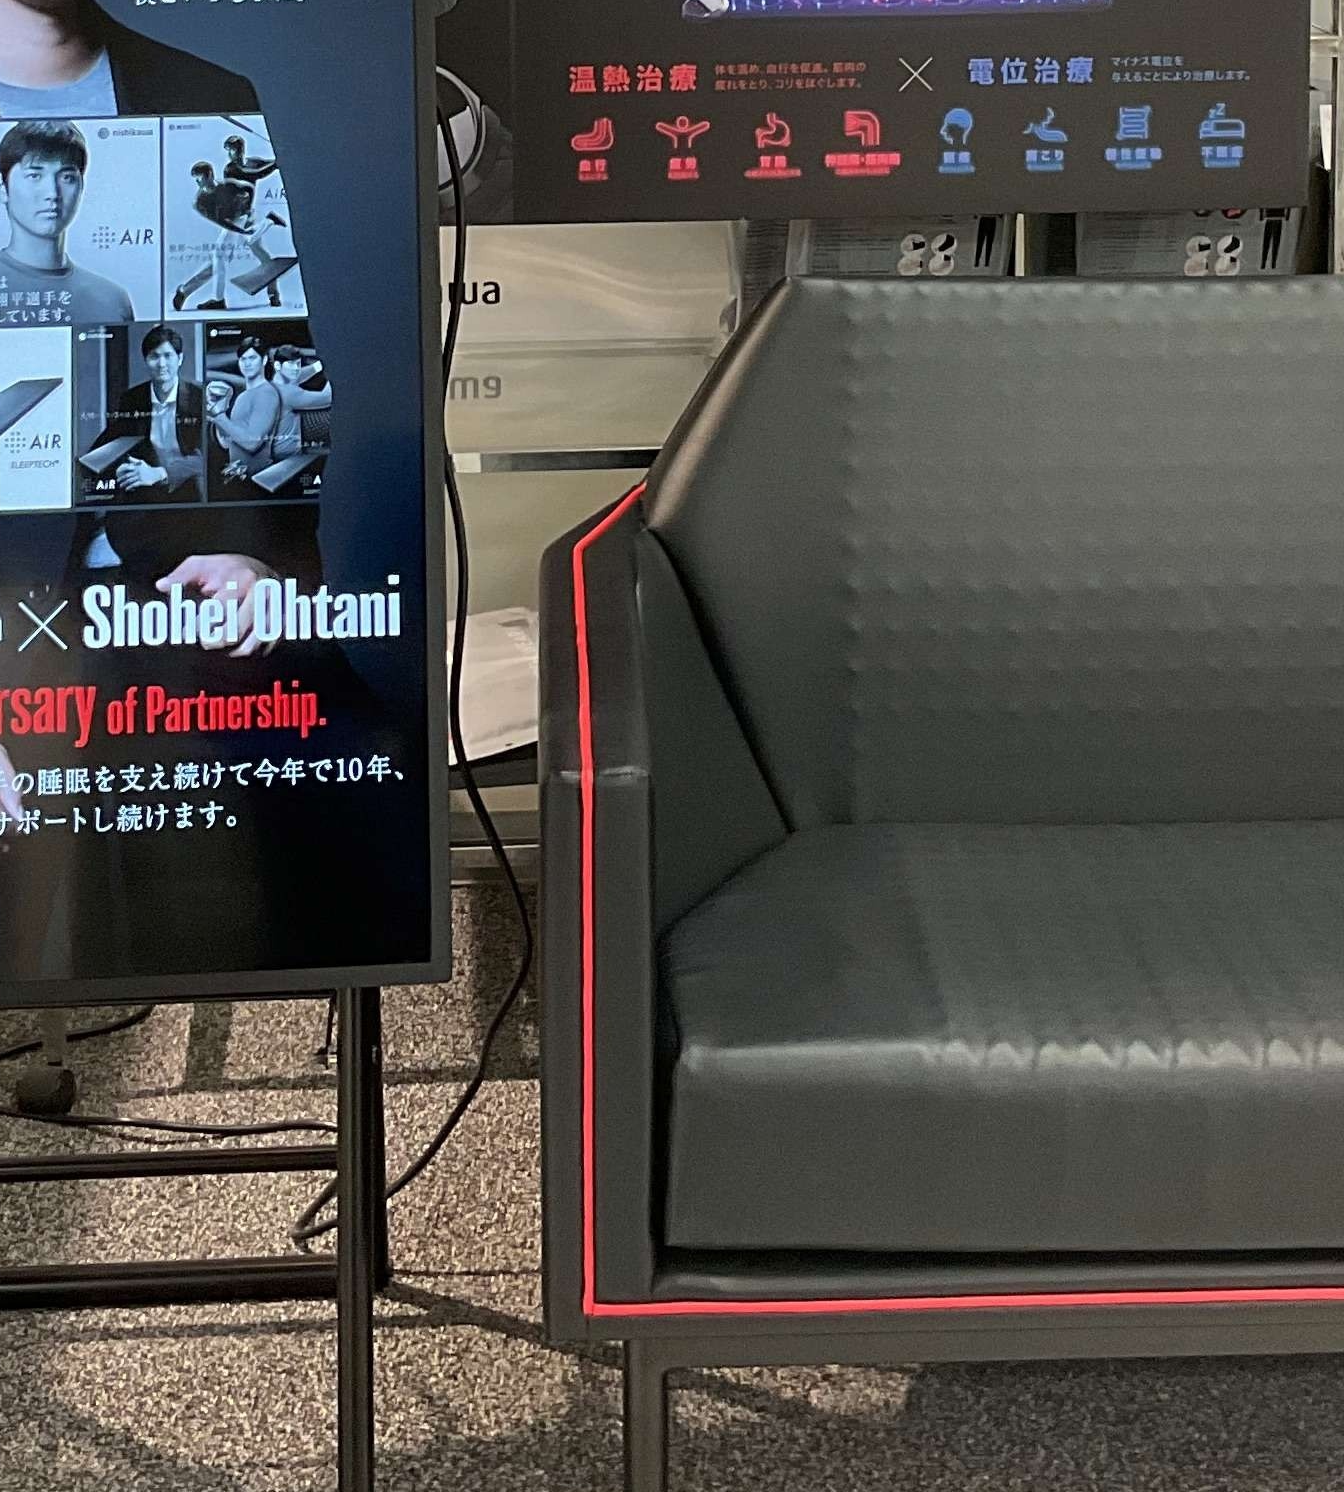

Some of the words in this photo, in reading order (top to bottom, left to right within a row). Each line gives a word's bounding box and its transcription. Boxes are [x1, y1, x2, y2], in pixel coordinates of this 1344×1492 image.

[569, 64, 698, 93] 温熱治療
[968, 57, 1095, 86] 電位治療
[84, 582, 241, 650] Shohei
[254, 575, 401, 643] Ohtani
[107, 685, 138, 734] of
[146, 680, 327, 739] Partnership.
